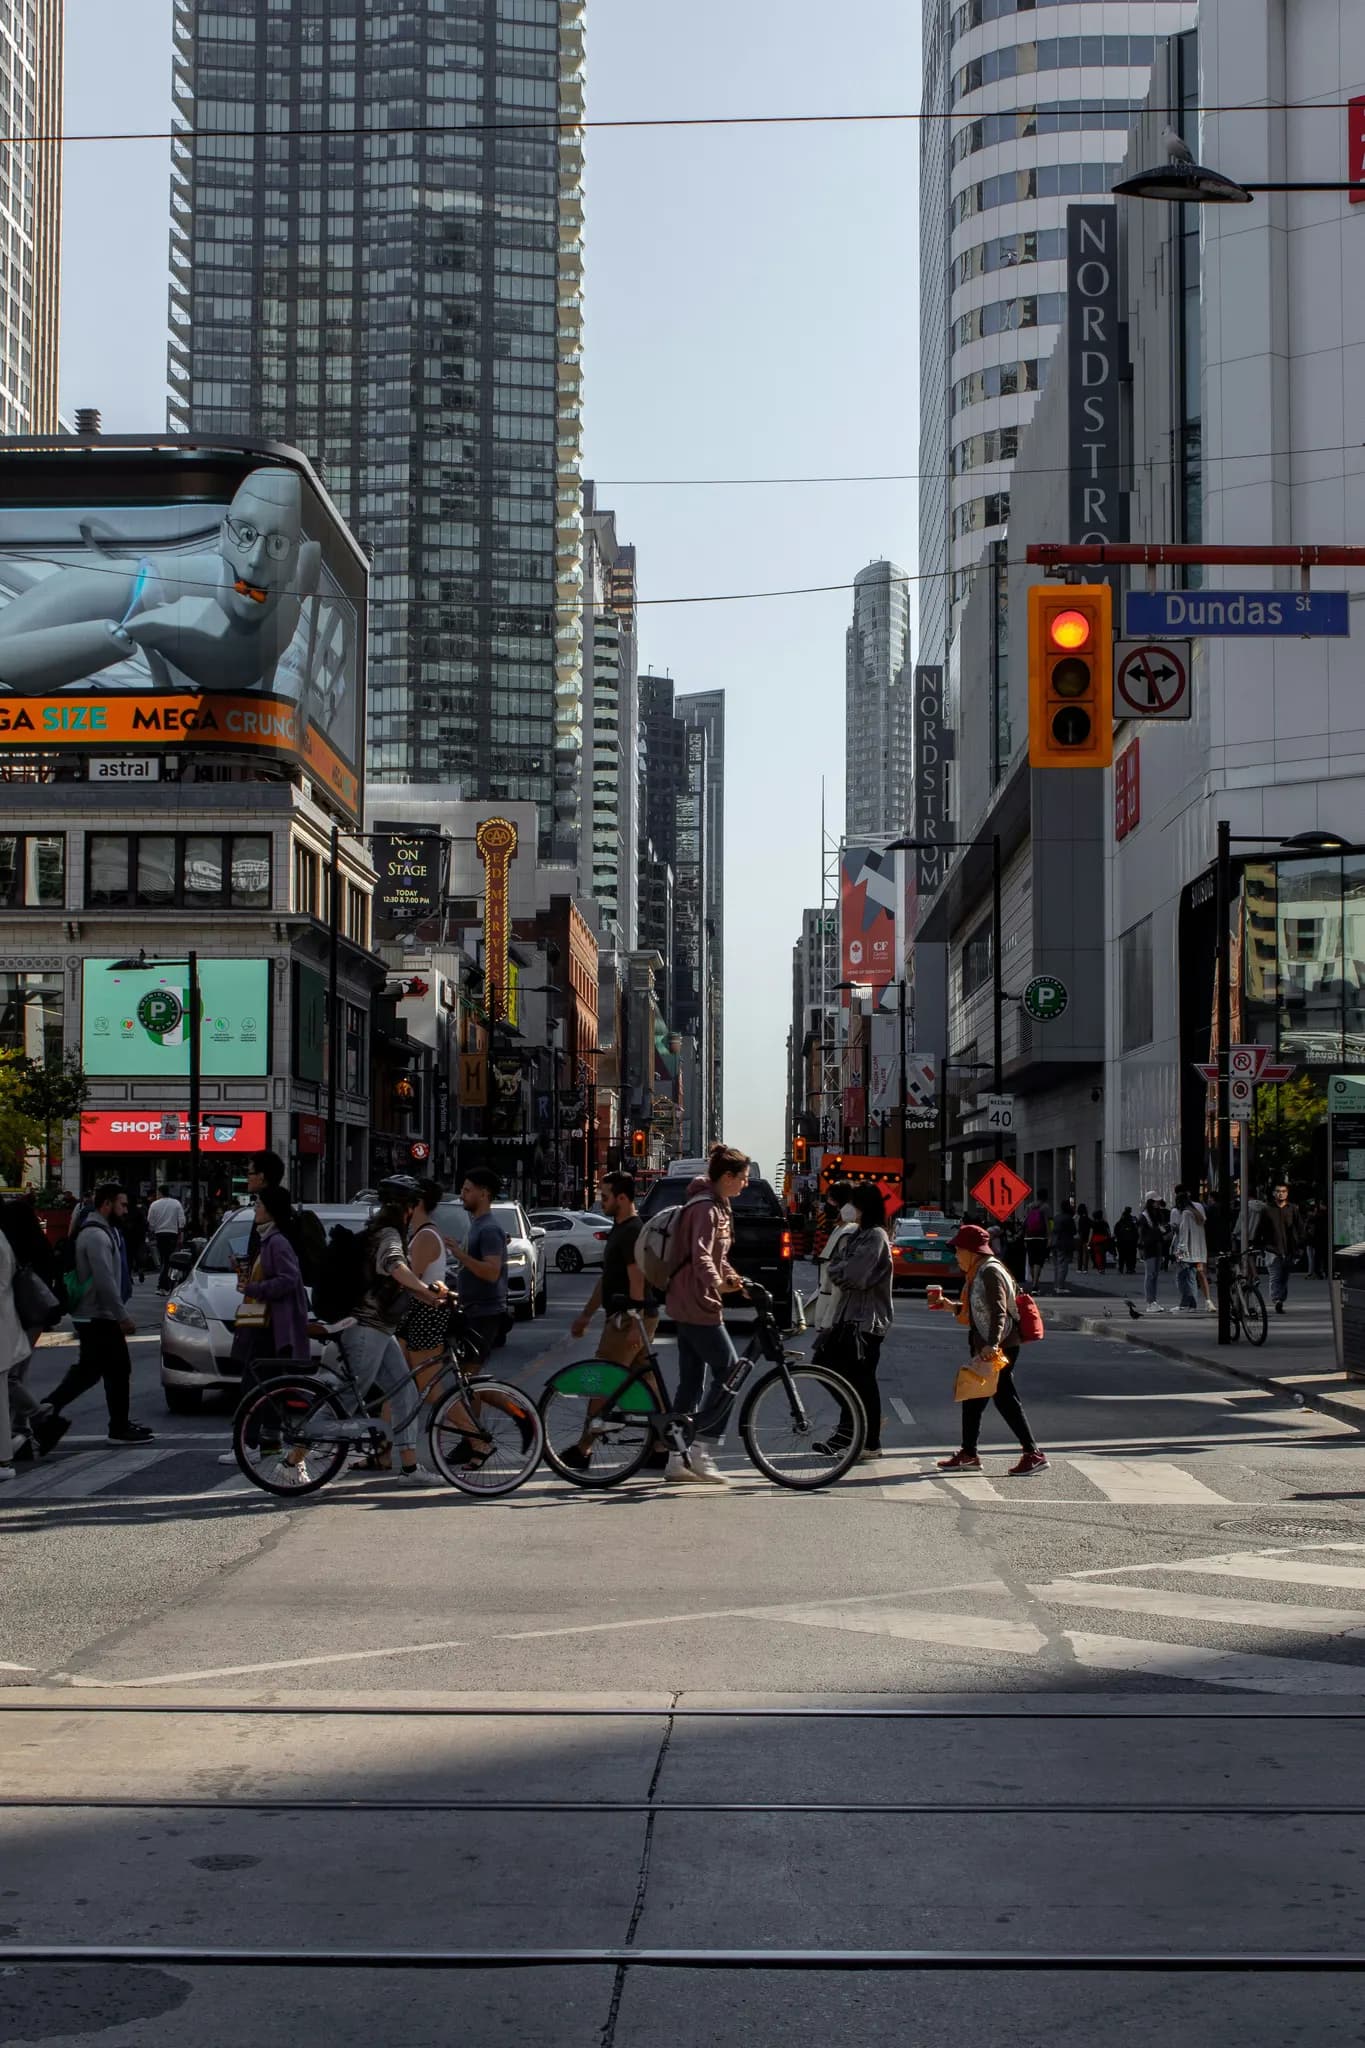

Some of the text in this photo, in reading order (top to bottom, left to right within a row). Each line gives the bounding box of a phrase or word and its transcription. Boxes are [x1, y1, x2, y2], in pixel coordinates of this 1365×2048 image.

[1166, 595, 1312, 625] Dundas St
[42, 706, 108, 730] SIZE
[131, 706, 219, 731] MEGA
[98, 760, 150, 777] astral
[920, 672, 938, 886] NORDSTROM
[397, 849, 419, 860] ON
[387, 861, 427, 876] STAGE
[395, 889, 418, 897] TODAY
[1038, 987, 1056, 1004] P
[150, 1001, 167, 1017] P
[110, 1121, 210, 1133] SHOPES
[904, 1120, 935, 1129] Roots
[989, 1111, 1012, 1127] 40
[180, 1133, 209, 1141] MRT
